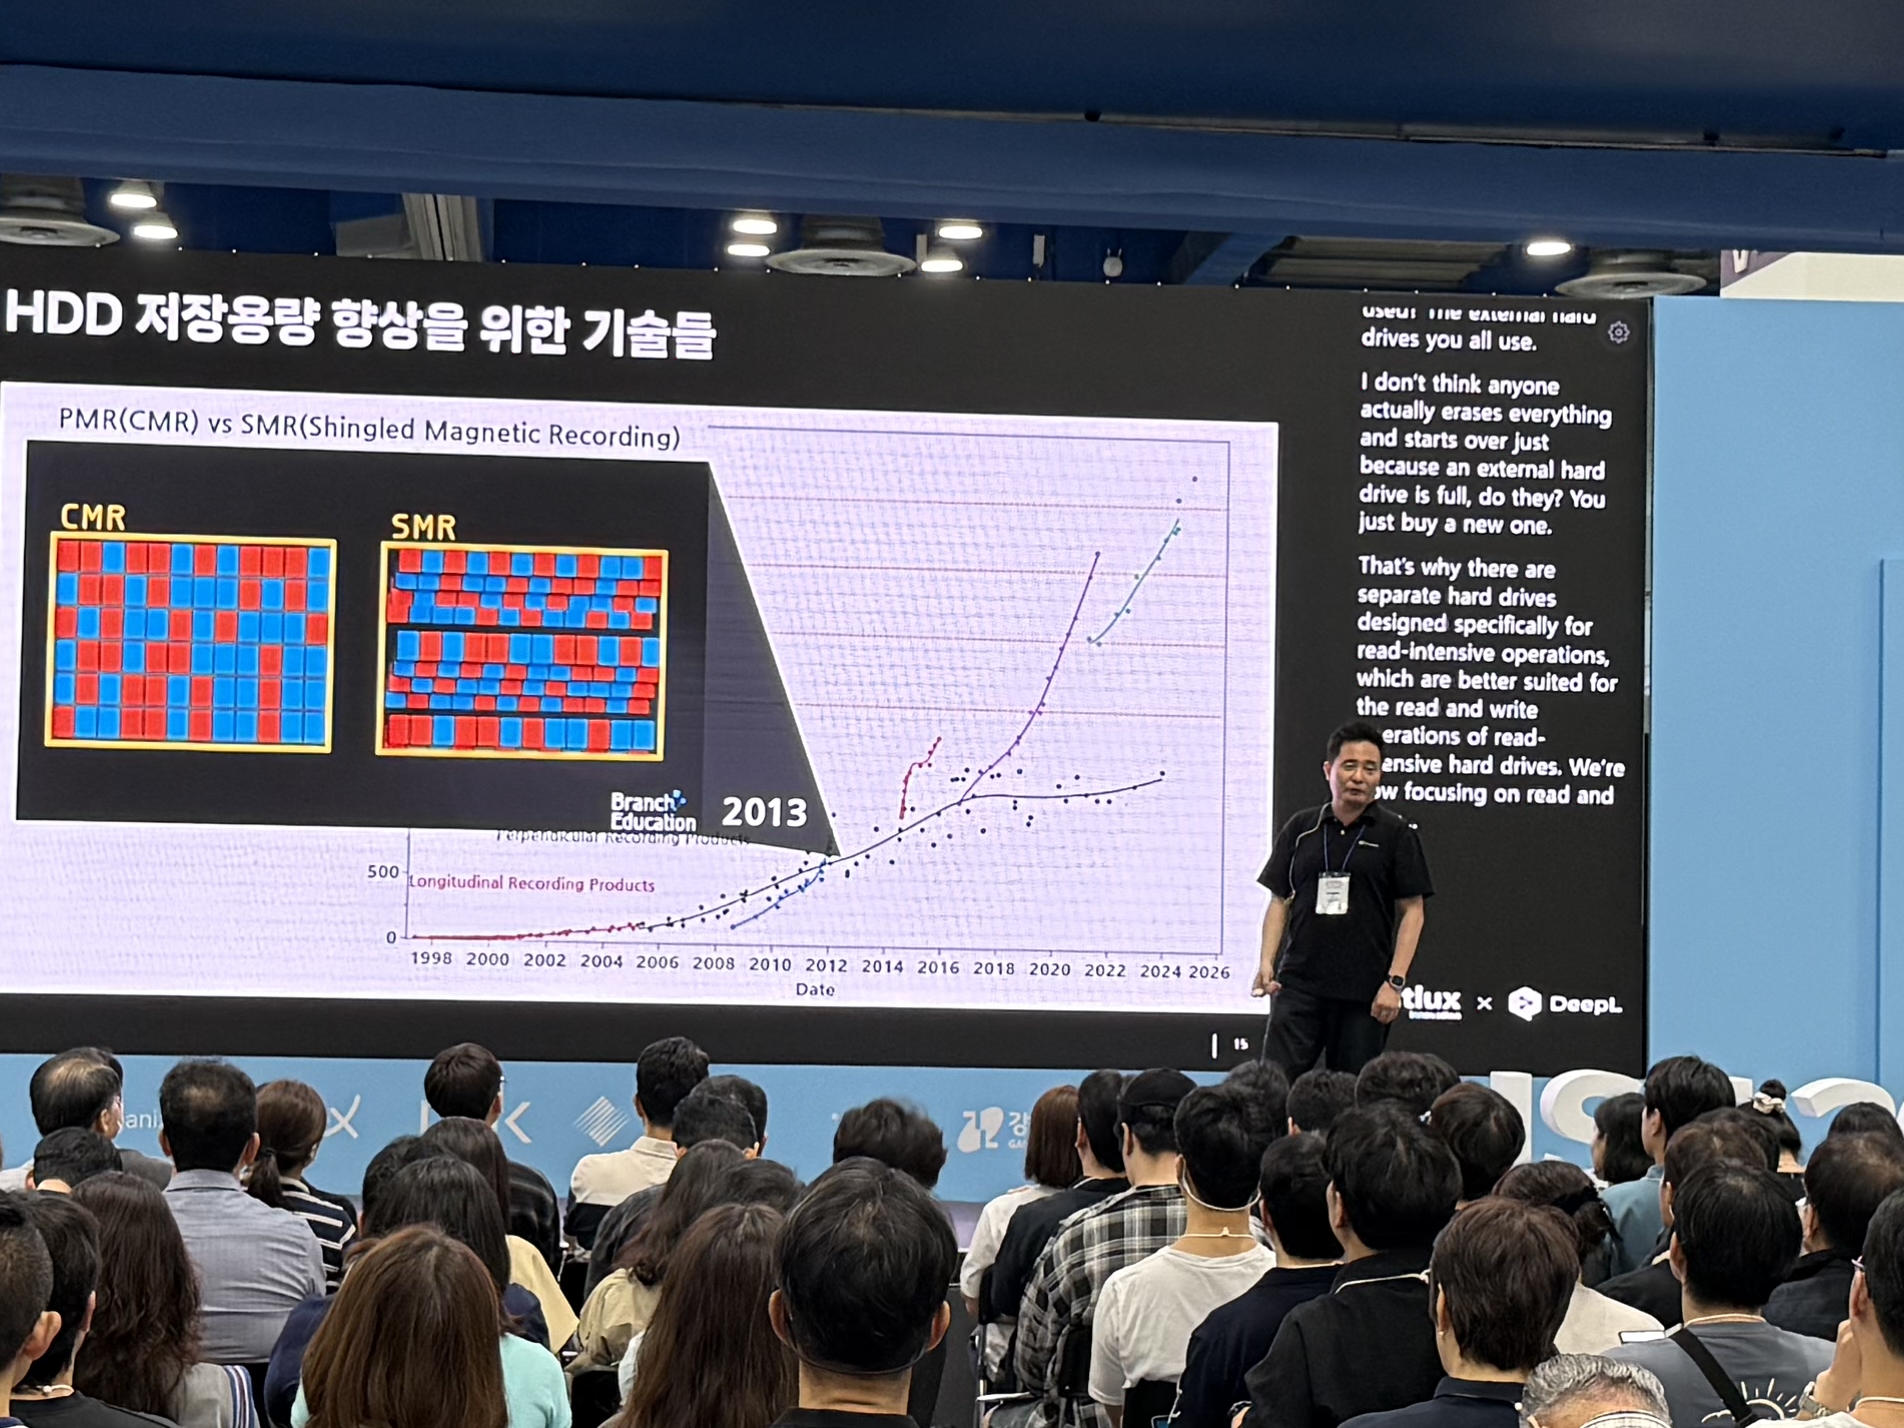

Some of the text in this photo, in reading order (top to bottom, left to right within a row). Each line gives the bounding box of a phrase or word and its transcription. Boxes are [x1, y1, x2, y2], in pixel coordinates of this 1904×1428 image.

[6, 288, 718, 361] HDD 저장용량 향상을 위한 기술들
[1361, 327, 1537, 353] drives you all use.
[1361, 371, 1560, 399] I don't think anyone
[1360, 400, 1613, 430] actually erases everything
[58, 406, 682, 453] PMR(CMR) vs SMR(Shingled Magnetic Recording)
[1360, 427, 1550, 456] and starts over just
[1360, 454, 1606, 481] because an external hard
[1359, 483, 1606, 511] drive is full, do they? You
[60, 502, 127, 532] CMR
[391, 513, 458, 542] SMR
[1358, 511, 1552, 537] just buy a new one.
[1358, 555, 1556, 581] That's why there are
[1357, 586, 1557, 608] separate hard drives
[1357, 612, 1594, 639] designed specifically for
[1356, 640, 1610, 668] read-intensive operations,
[1356, 668, 1619, 693] which are better suited for
[1356, 696, 1538, 720] the read and write
[1382, 726, 1546, 747] erations of read-
[1382, 754, 1626, 778] ensive hard drives. We're
[611, 790, 676, 814] Branch
[1375, 781, 1614, 807] ow focusing on read and
[611, 811, 697, 833] Education
[722, 795, 809, 828] 2013
[367, 865, 400, 880] 500
[409, 873, 656, 894] Longitudinal Recording Products
[386, 931, 397, 945] 0
[411, 950, 1231, 981] 1998 2000 2002 2004 2006 2008 2010 2012 2014 2016 2018 2020 2022 2024 2026
[795, 983, 836, 998] Date
[1401, 984, 1624, 1016] tlux DeepL
[1233, 1036, 1250, 1052] 15
